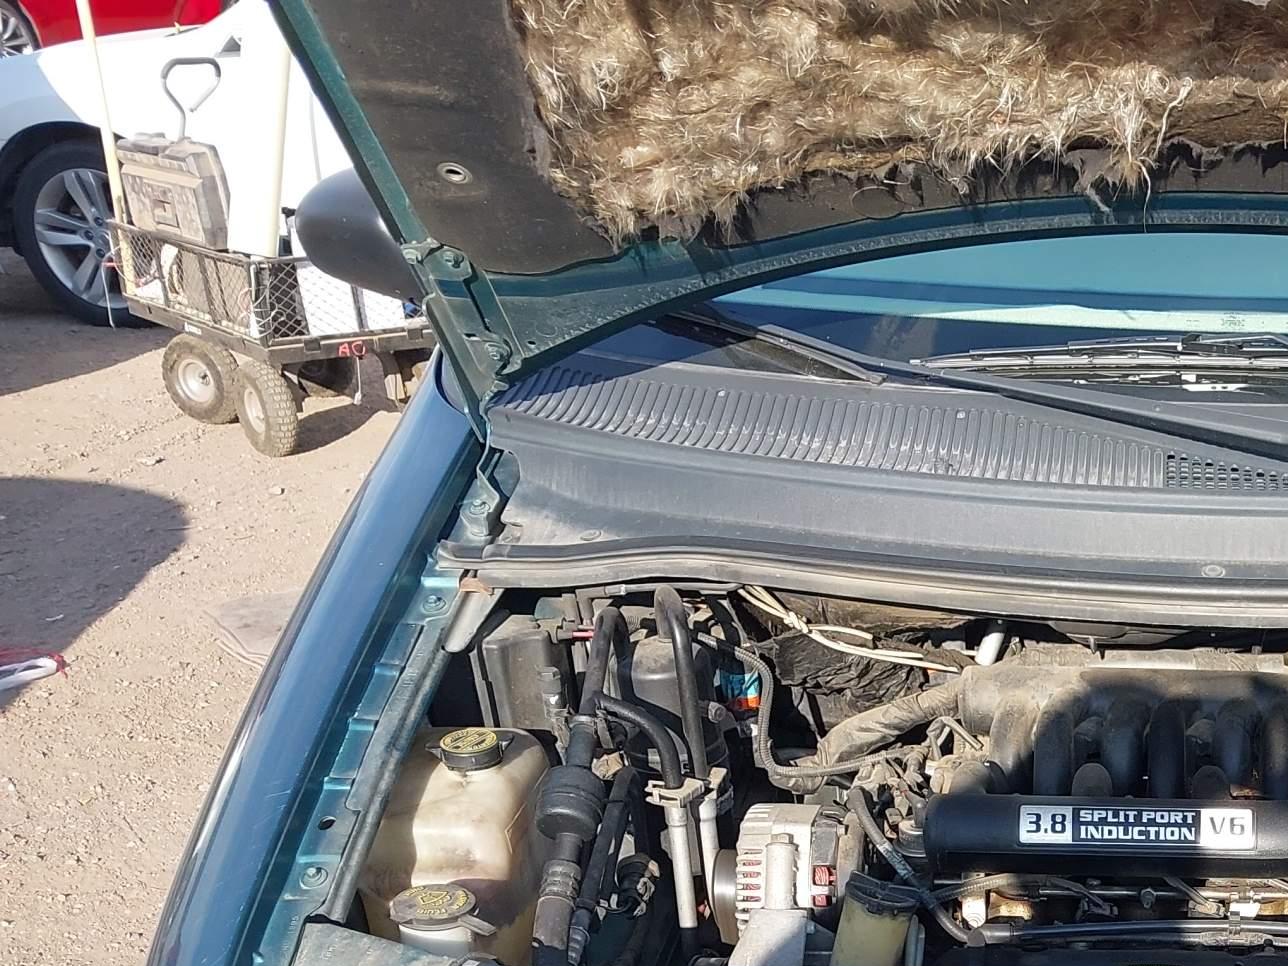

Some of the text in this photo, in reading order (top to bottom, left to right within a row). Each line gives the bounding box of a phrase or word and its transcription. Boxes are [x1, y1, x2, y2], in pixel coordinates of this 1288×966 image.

[1025, 812, 1067, 834] 3.8
[1079, 809, 1196, 824] SPLIT PORT
[1208, 815, 1246, 836] V6
[1079, 825, 1196, 841] INDUCTION
